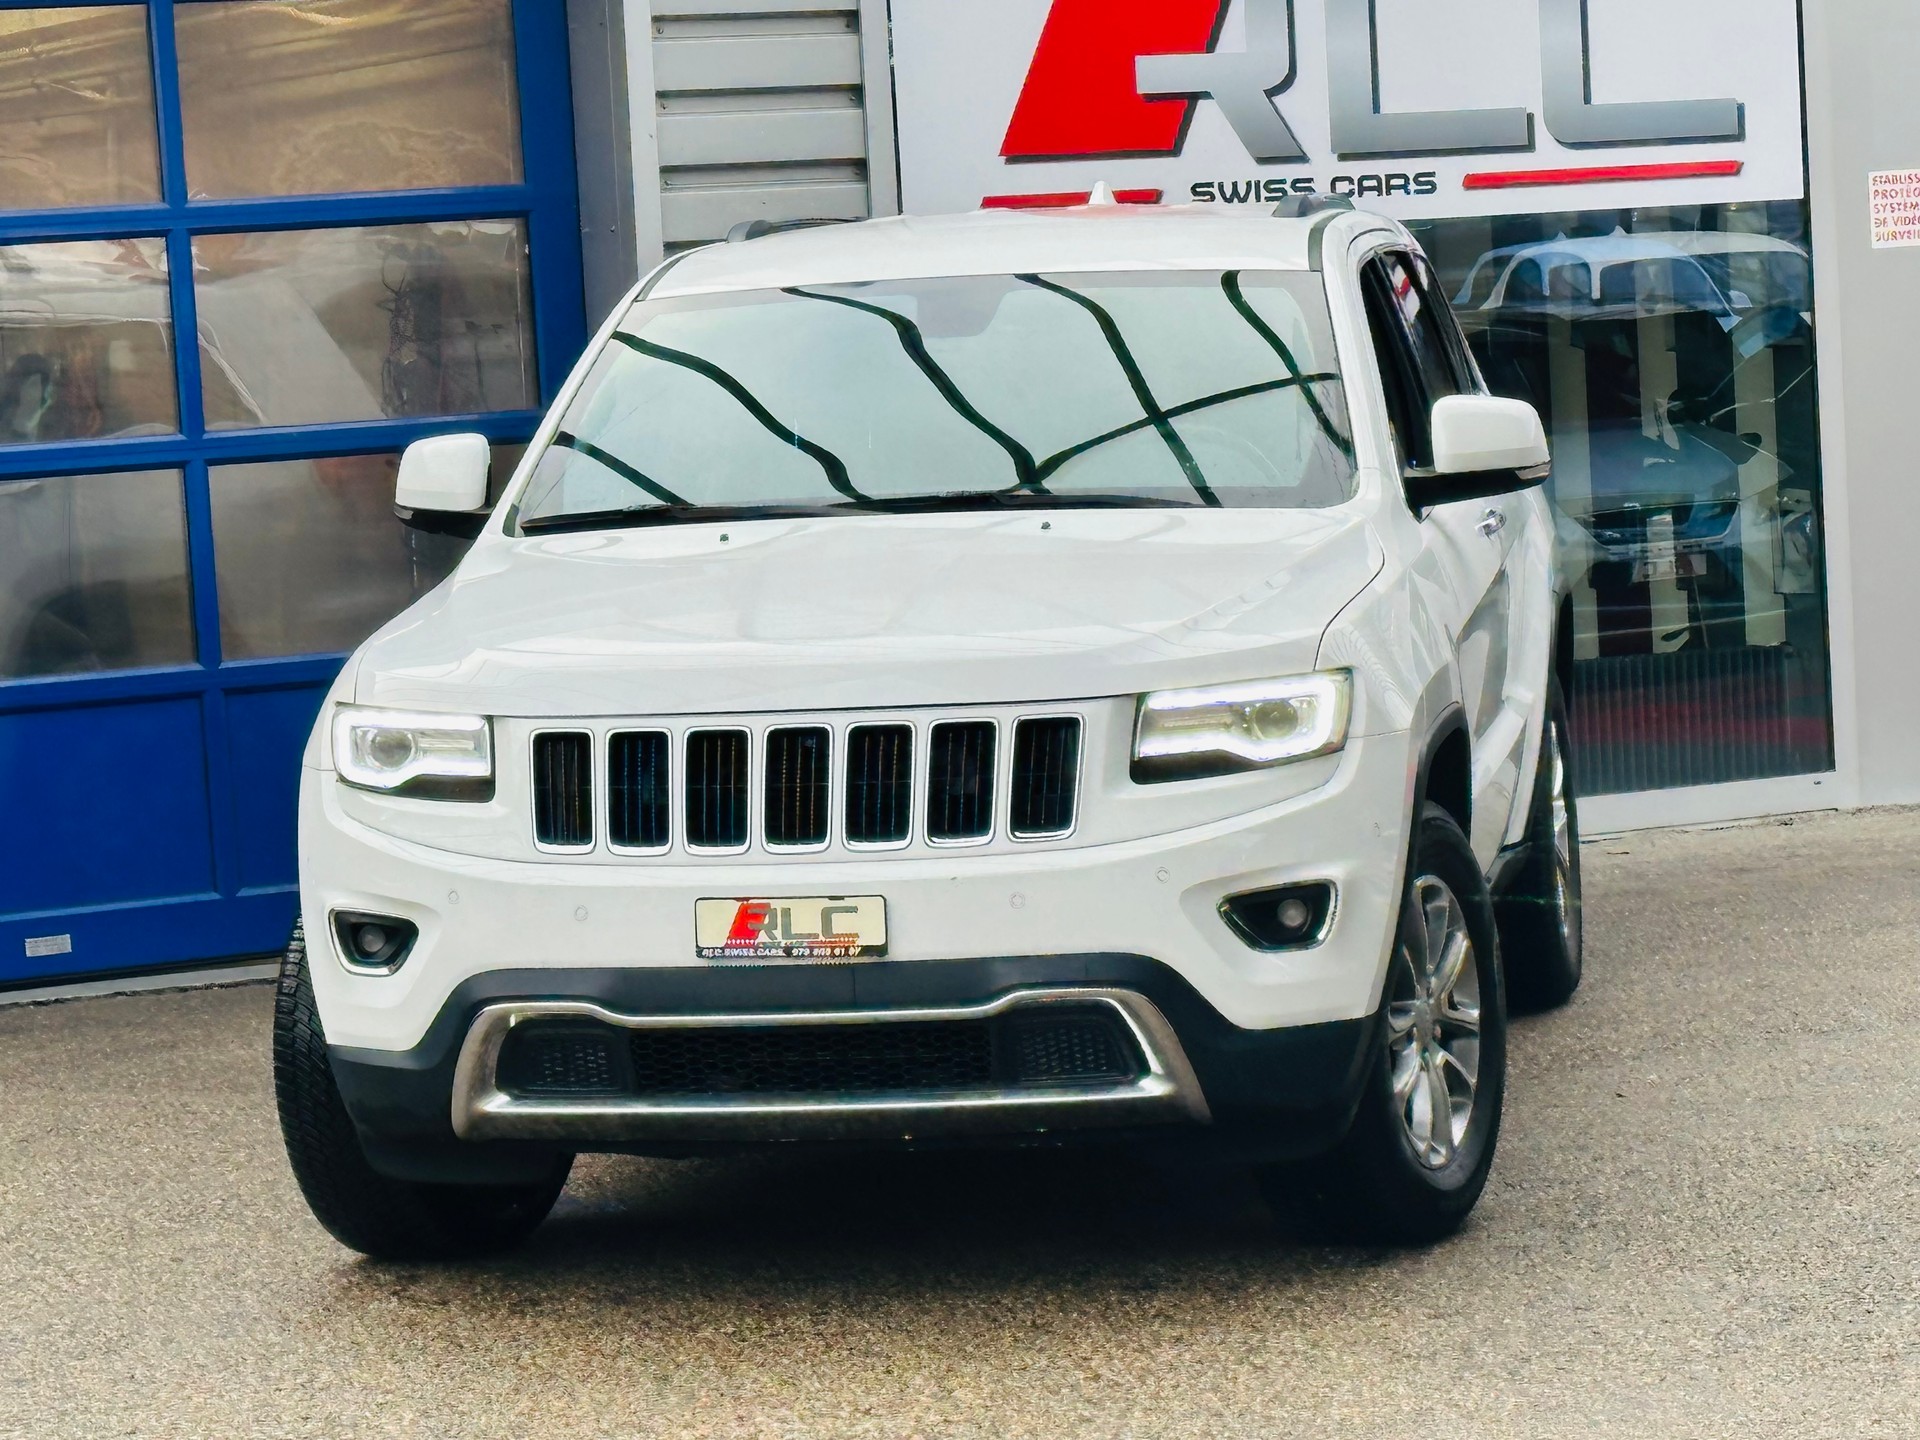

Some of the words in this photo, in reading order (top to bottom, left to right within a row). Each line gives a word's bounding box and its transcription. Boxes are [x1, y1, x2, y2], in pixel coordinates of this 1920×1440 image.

[1190, 177, 1316, 203] SWISS
[1330, 171, 1437, 198] CARS
[747, 906, 859, 941] RLC
